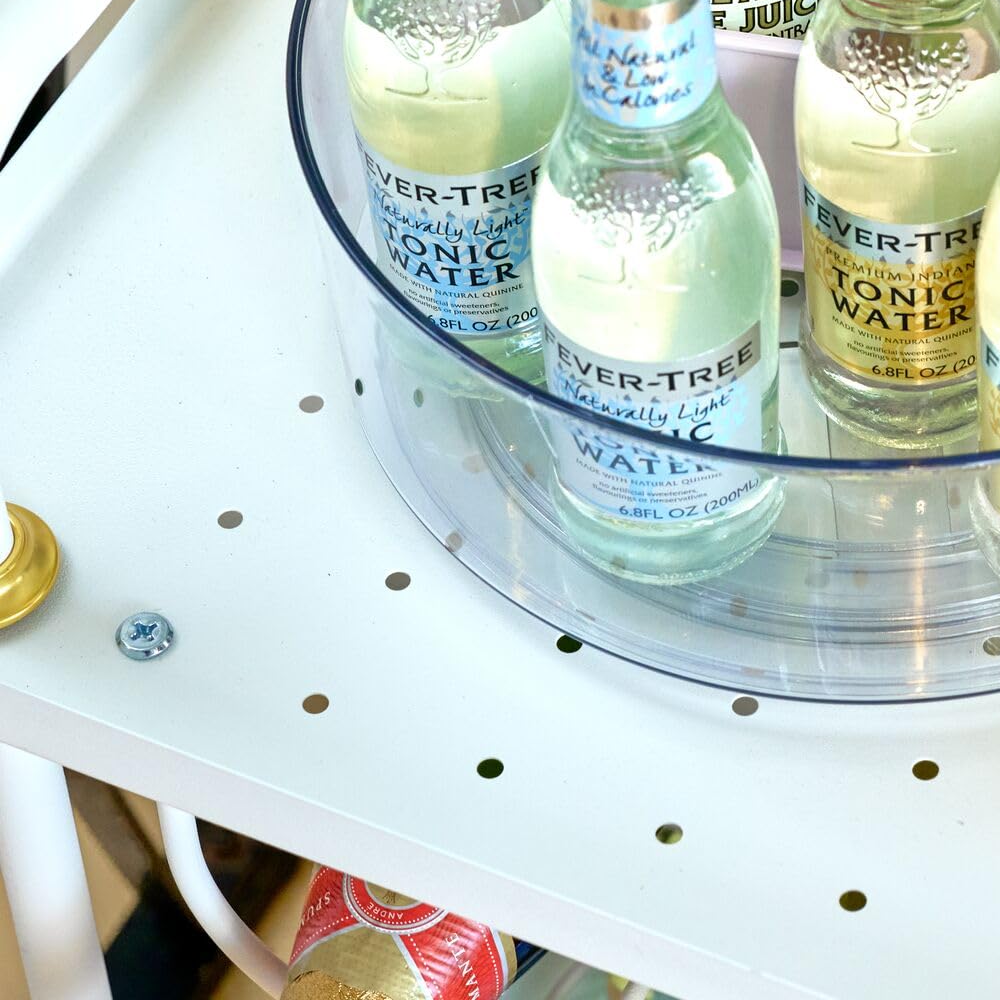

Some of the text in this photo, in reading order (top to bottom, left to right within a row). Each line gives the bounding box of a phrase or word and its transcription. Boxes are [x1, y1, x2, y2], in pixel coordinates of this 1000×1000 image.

[606, 29, 696, 68] Natural
[602, 81, 693, 109] Calories
[624, 69, 669, 88] Low
[373, 188, 463, 243] Naturally
[803, 185, 981, 253] FEVER-TRE
[383, 218, 510, 265] TONIC
[386, 238, 520, 287] WATER
[825, 247, 976, 282] PREMIUM INDIAN
[411, 279, 433, 294] WITH
[434, 288, 479, 299] NATURAL
[482, 283, 524, 298] QUININE
[418, 293, 449, 308] artificial
[832, 266, 965, 308] TONIC
[453, 304, 509, 316] preservatives
[472, 319, 501, 332] OZ
[506, 306, 539, 330] (200
[831, 290, 971, 332] WATER
[832, 315, 974, 346] MADE WITH NATURAL QUININE
[544, 324, 753, 392] FEVER-TREE
[847, 342, 890, 361] flavourings
[902, 351, 958, 364] preservatives
[865, 344, 898, 356] artificial
[872, 365, 914, 379] 6.8FL
[920, 365, 948, 378] OZ
[564, 378, 668, 428] Naturally
[618, 478, 760, 519] 6.8FL OZ (200ML)
[630, 479, 678, 488] NATURAL
